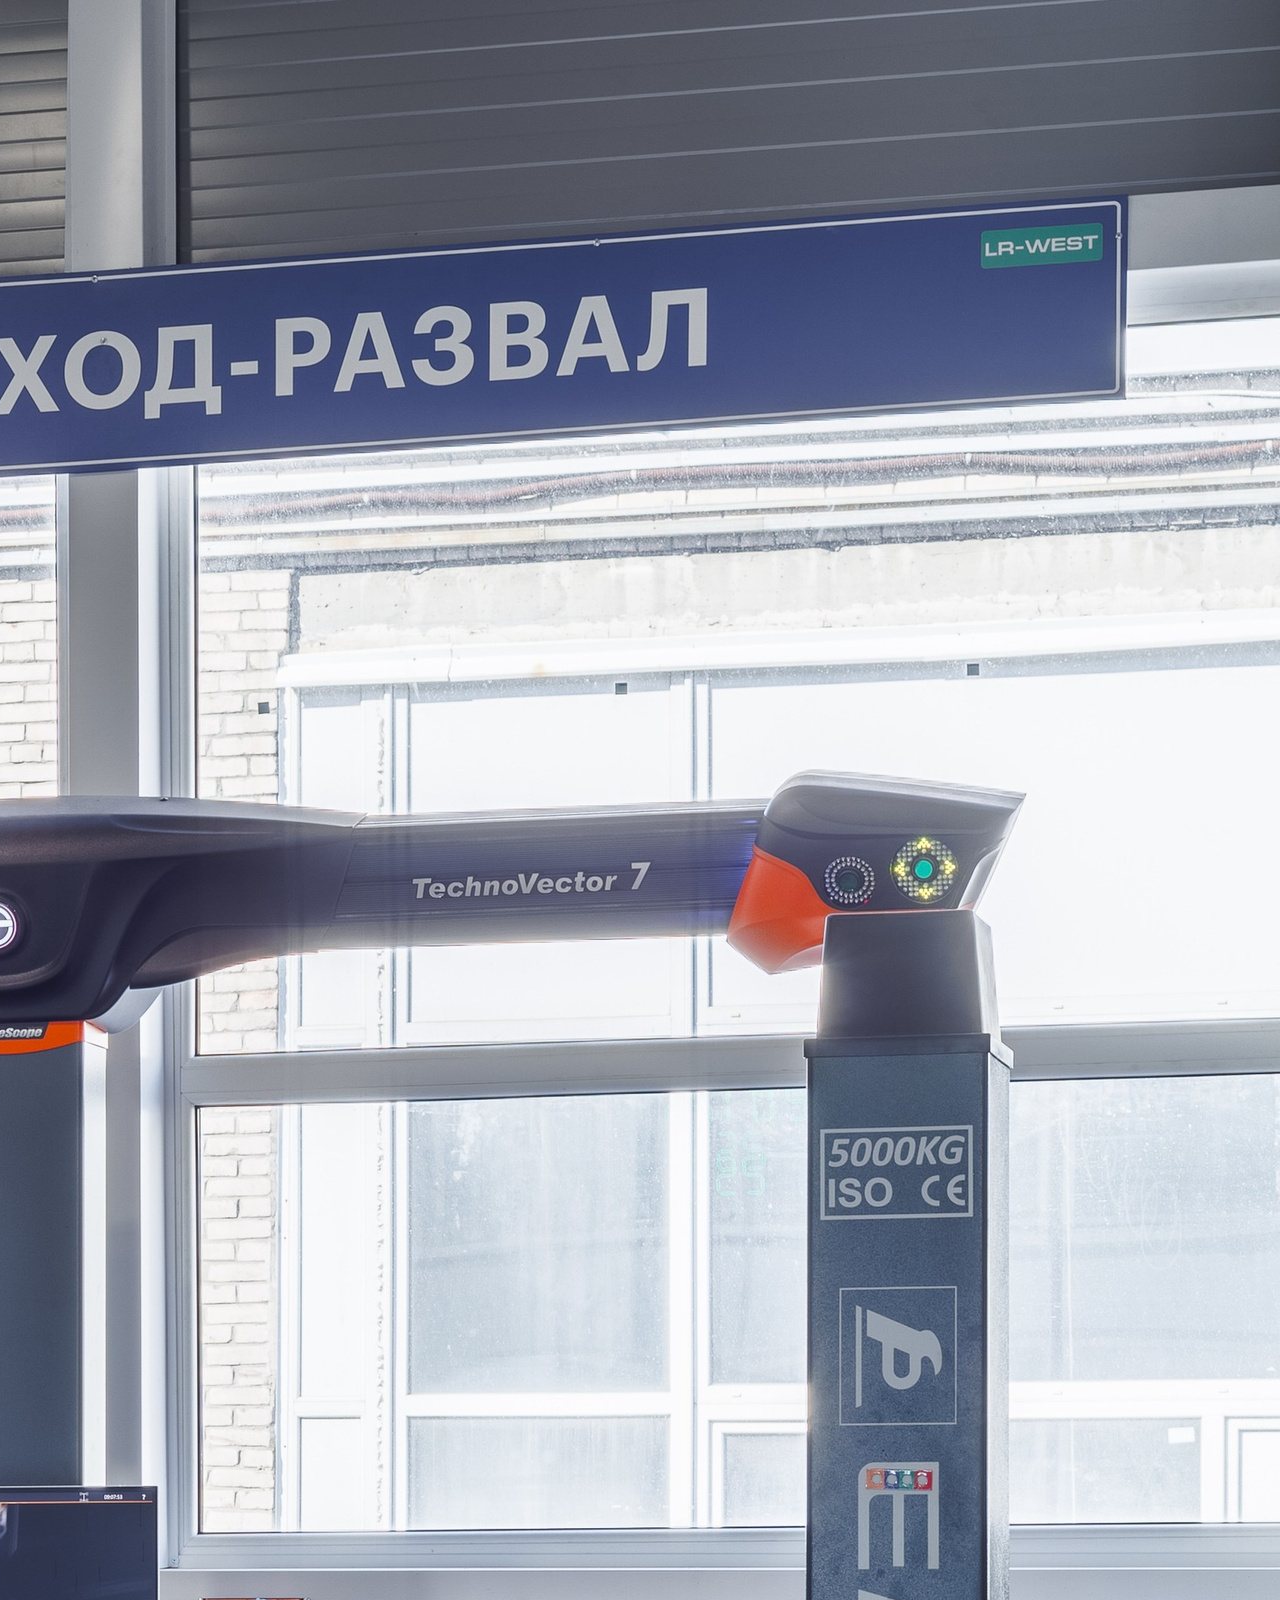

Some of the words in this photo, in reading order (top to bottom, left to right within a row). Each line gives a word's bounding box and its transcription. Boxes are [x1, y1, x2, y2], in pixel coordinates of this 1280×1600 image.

[985, 235, 1099, 257] LR-WEST
[412, 871, 618, 899] TechnoVector
[630, 861, 651, 890] 7
[828, 1135, 965, 1167] 5000KG
[828, 1177, 893, 1208] ISO
